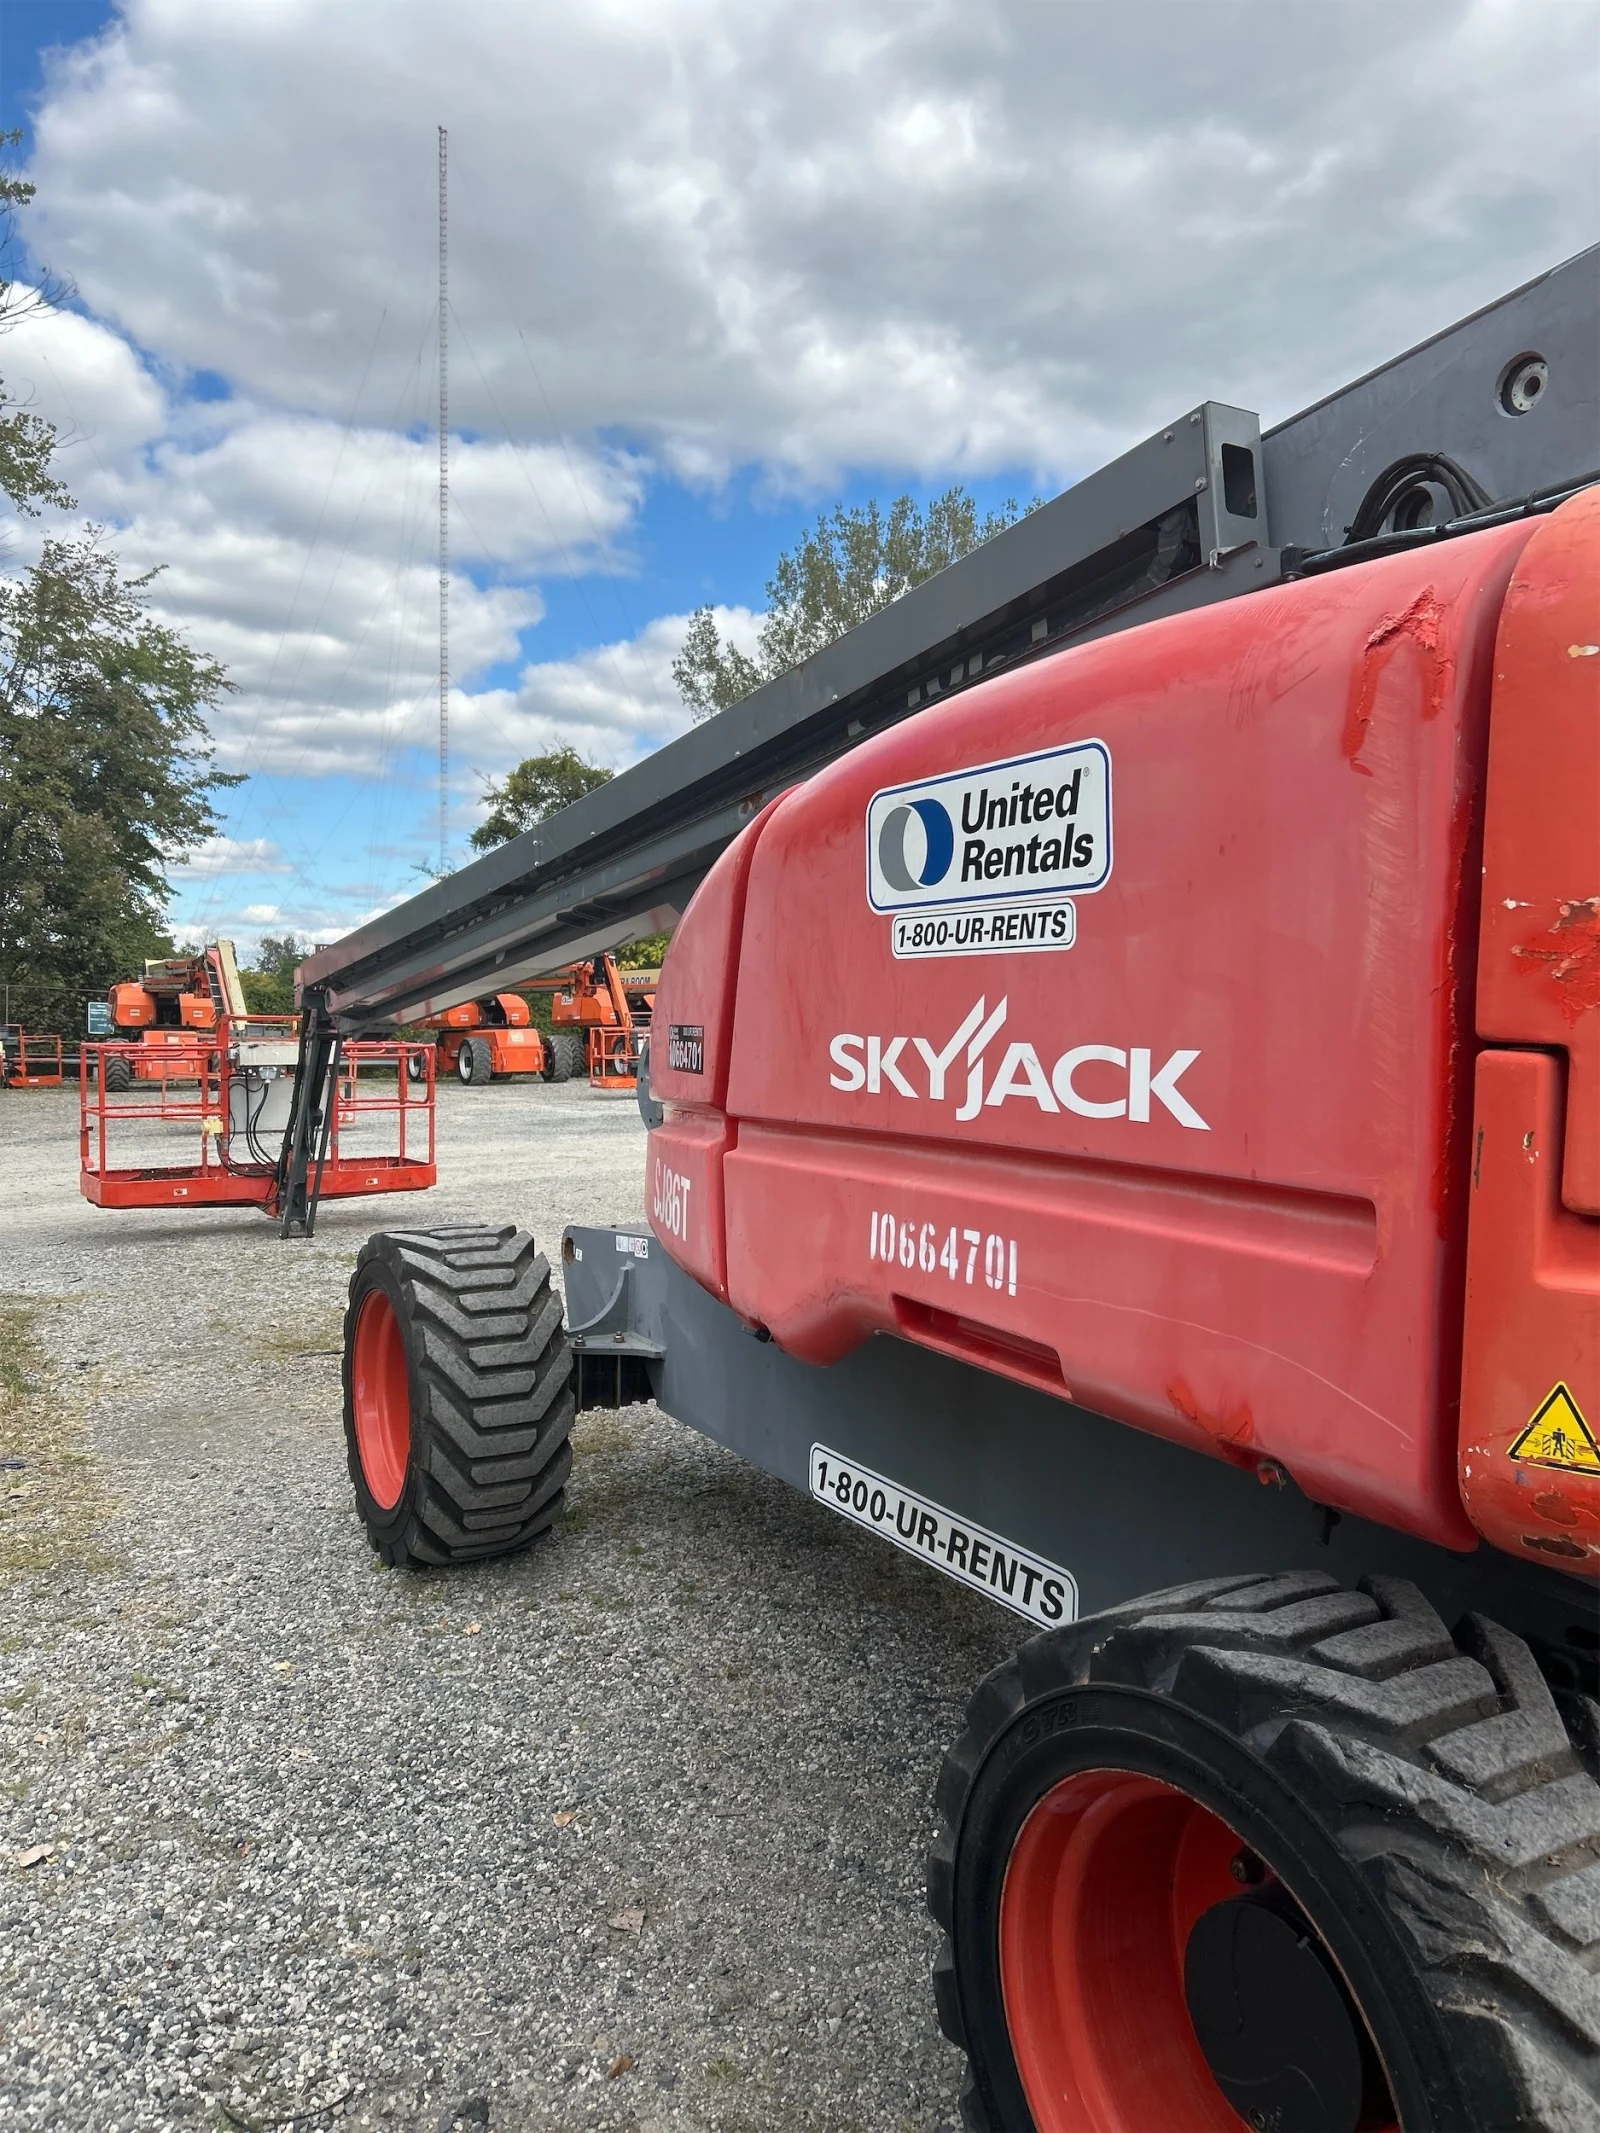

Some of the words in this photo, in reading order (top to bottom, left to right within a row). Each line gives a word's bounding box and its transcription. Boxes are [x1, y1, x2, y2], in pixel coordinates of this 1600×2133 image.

[961, 768, 1082, 834] United
[961, 823, 1093, 882] Rentals
[898, 909, 1067, 948] 1-800-UR-RENTS
[829, 994, 1211, 1131] SKYJACK
[654, 1157, 691, 1242] SJ86T
[870, 1211, 1018, 1297] 10664701
[817, 1461, 1065, 1621] 1-800-UR-RENTS
